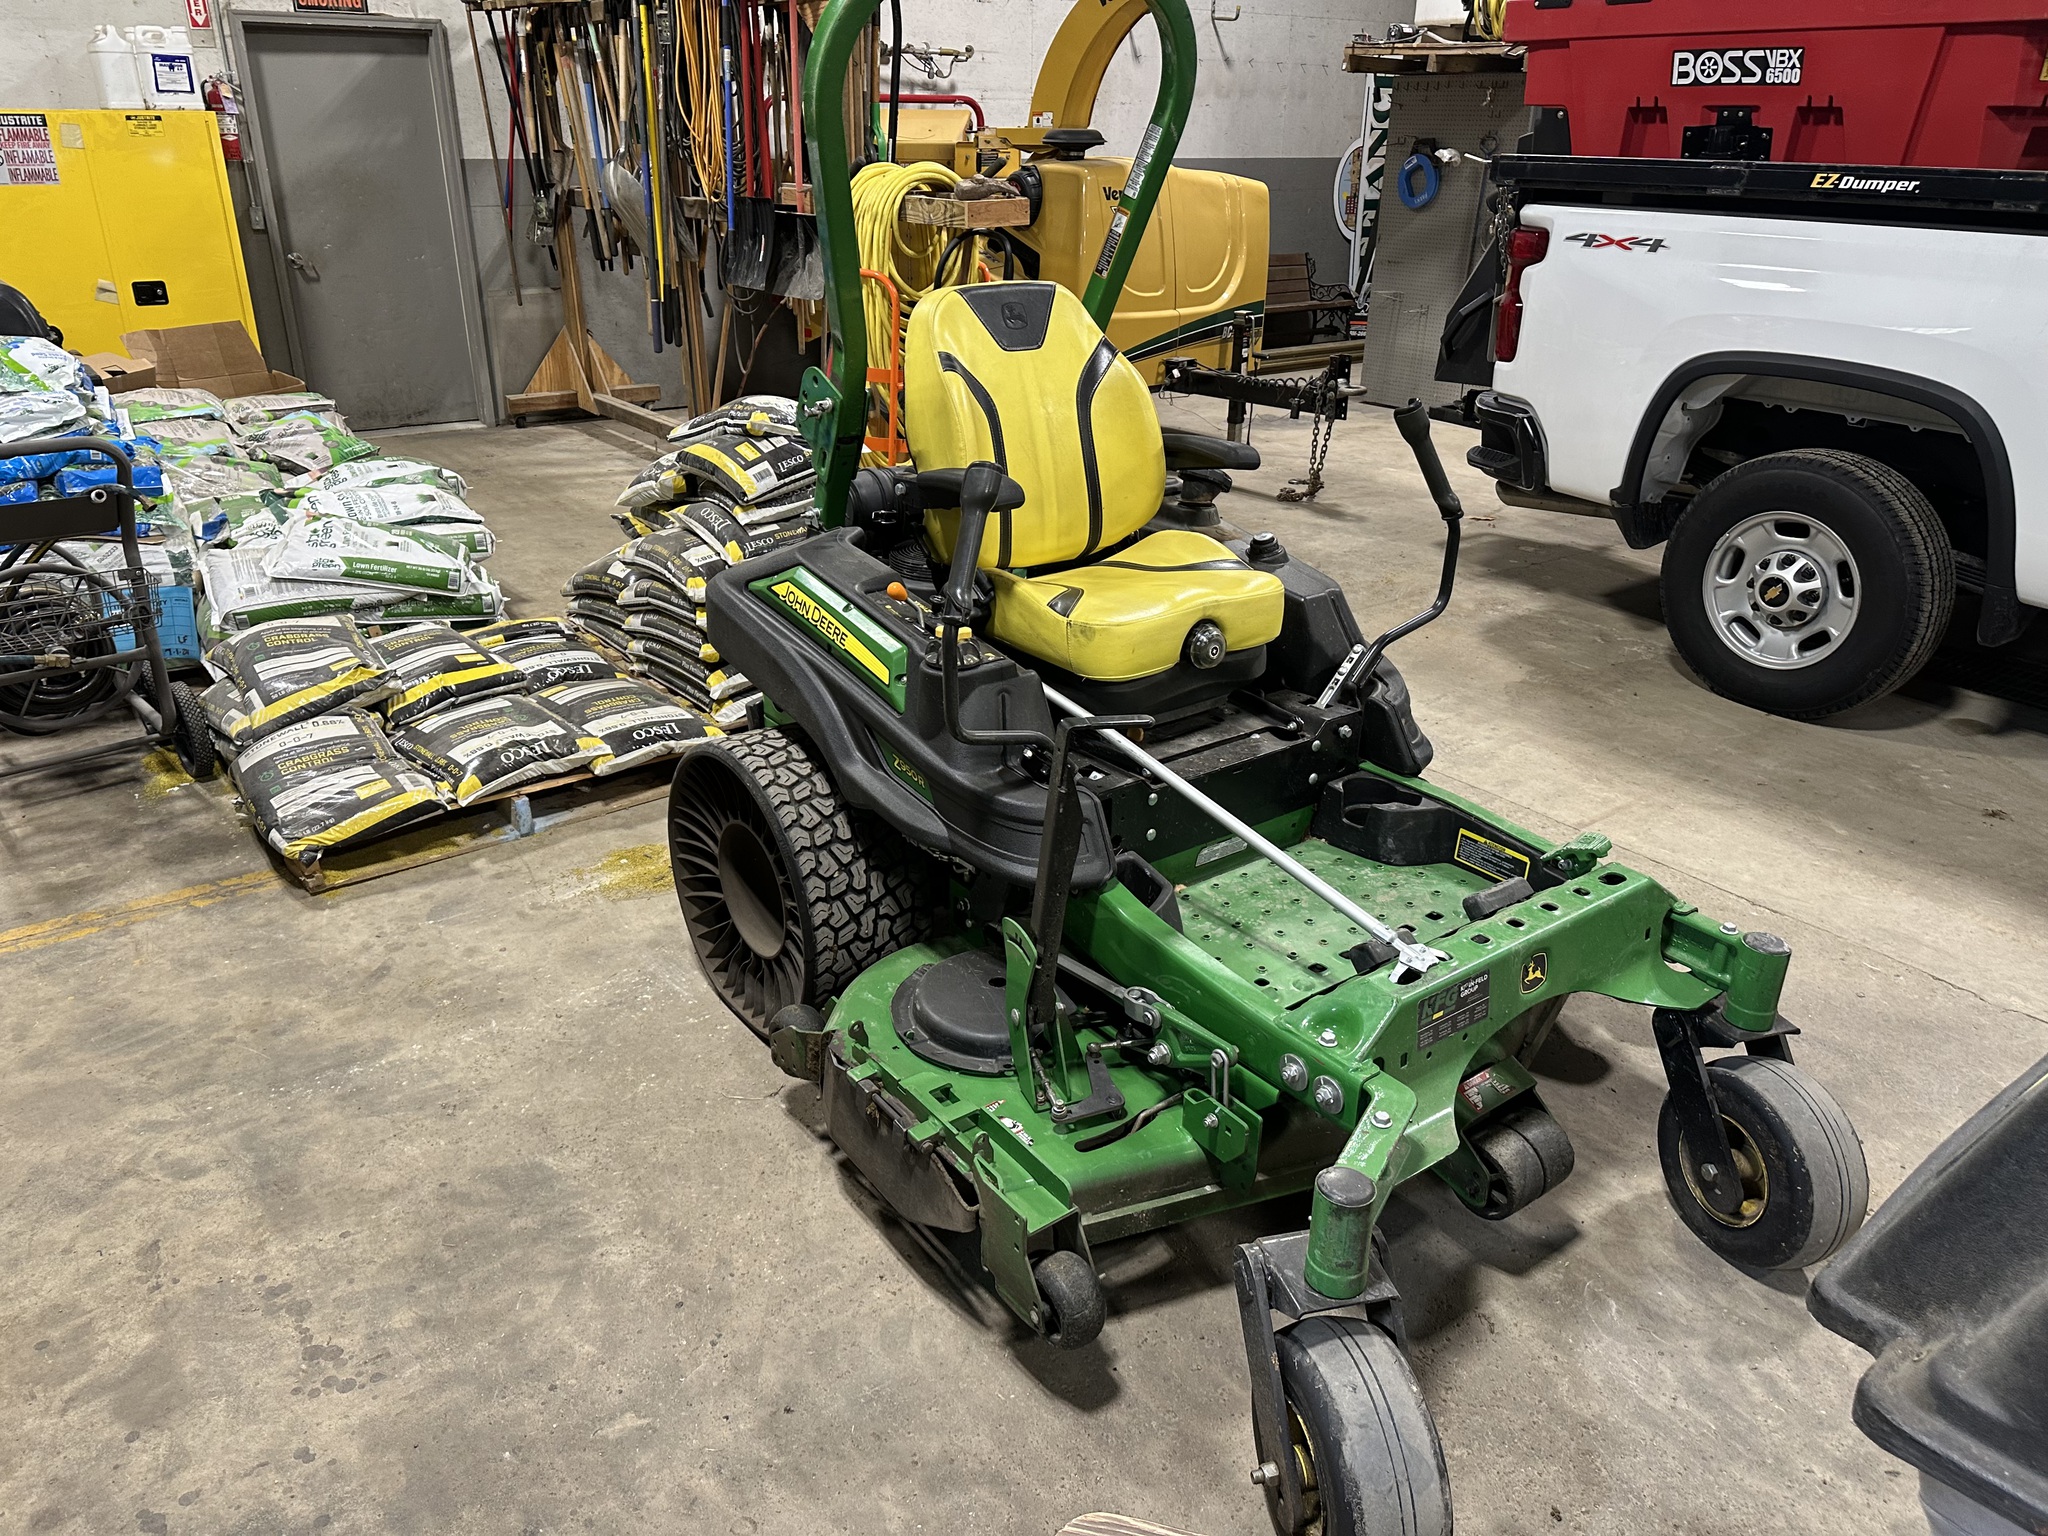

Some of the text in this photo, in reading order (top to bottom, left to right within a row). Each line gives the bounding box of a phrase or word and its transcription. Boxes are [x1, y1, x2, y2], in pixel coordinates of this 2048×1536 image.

[1672, 50, 1764, 85] BOSS
[1765, 49, 1803, 68] VBX
[1765, 68, 1801, 84] 6500
[778, 454, 804, 473] LESCO
[700, 507, 732, 531] LESCO
[745, 536, 774, 552] LESCO
[370, 563, 397, 573] Fertilizer
[780, 586, 848, 648] JOHN DEERE
[264, 633, 330, 642] CRABGRASS
[266, 637, 318, 648] CONTROL
[547, 664, 594, 681] LESCO
[244, 719, 344, 759] STONEWALL 0.68%
[632, 722, 682, 740] LESCO
[279, 733, 313, 748] 0-0-7
[278, 746, 350, 770] CRABGRASS
[500, 740, 552, 764] LESCO
[281, 756, 334, 776] CONTROL
[447, 763, 464, 777] 0-0-7
[1460, 984, 1479, 998] GROUP
